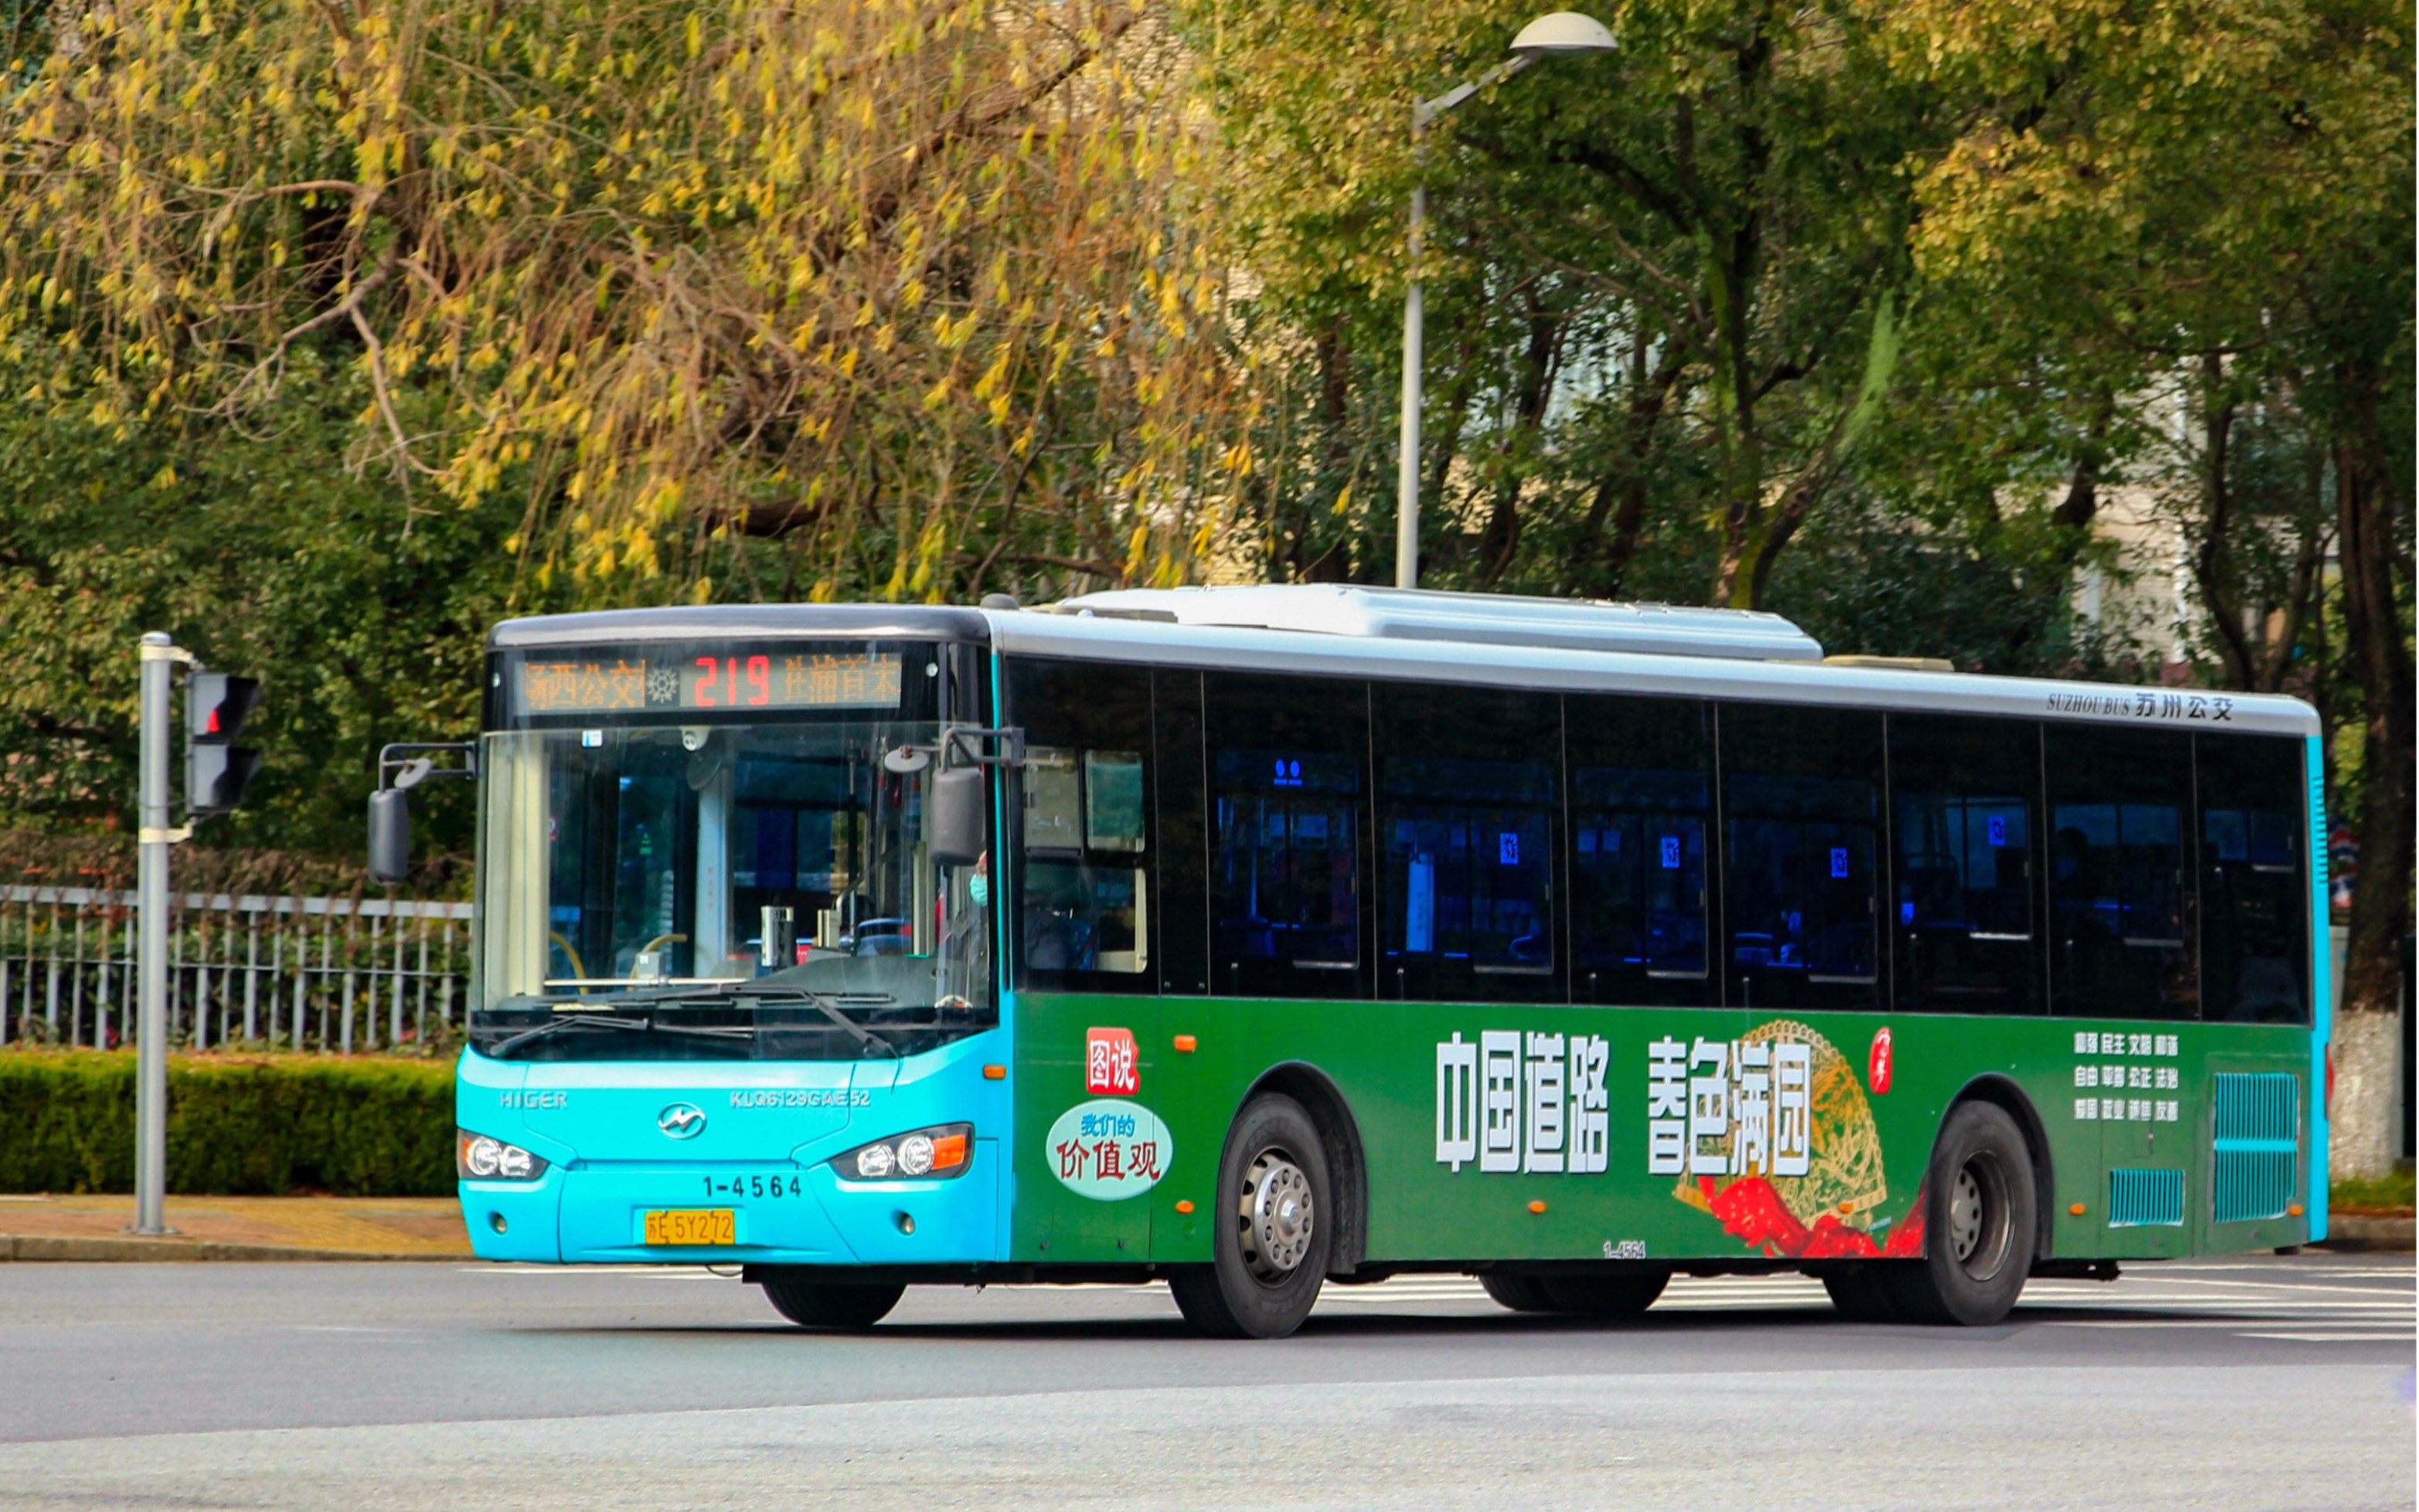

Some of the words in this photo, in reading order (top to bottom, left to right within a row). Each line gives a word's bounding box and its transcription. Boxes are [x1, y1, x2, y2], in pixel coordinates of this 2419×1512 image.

[695, 655, 770, 707] 219
[2047, 693, 2103, 713] SUZHOU
[2103, 698, 2130, 715] BUS
[2135, 692, 2234, 721] 苏州公交
[2101, 1032, 2125, 1055] 民主
[2128, 1034, 2152, 1055] 文明
[1090, 1039, 1135, 1091] 图说
[2074, 1065, 2098, 1087] 自由
[2128, 1066, 2152, 1089] 公正
[500, 1091, 568, 1109] HIGER
[1436, 1031, 1609, 1174] 中国道路
[1647, 1035, 1812, 1177] 春色满园
[1081, 1113, 1136, 1137] 我们的
[1056, 1140, 1161, 1181] 价值观
[703, 1176, 801, 1198] 1-4564
[1603, 1241, 1646, 1259] 1-4564
